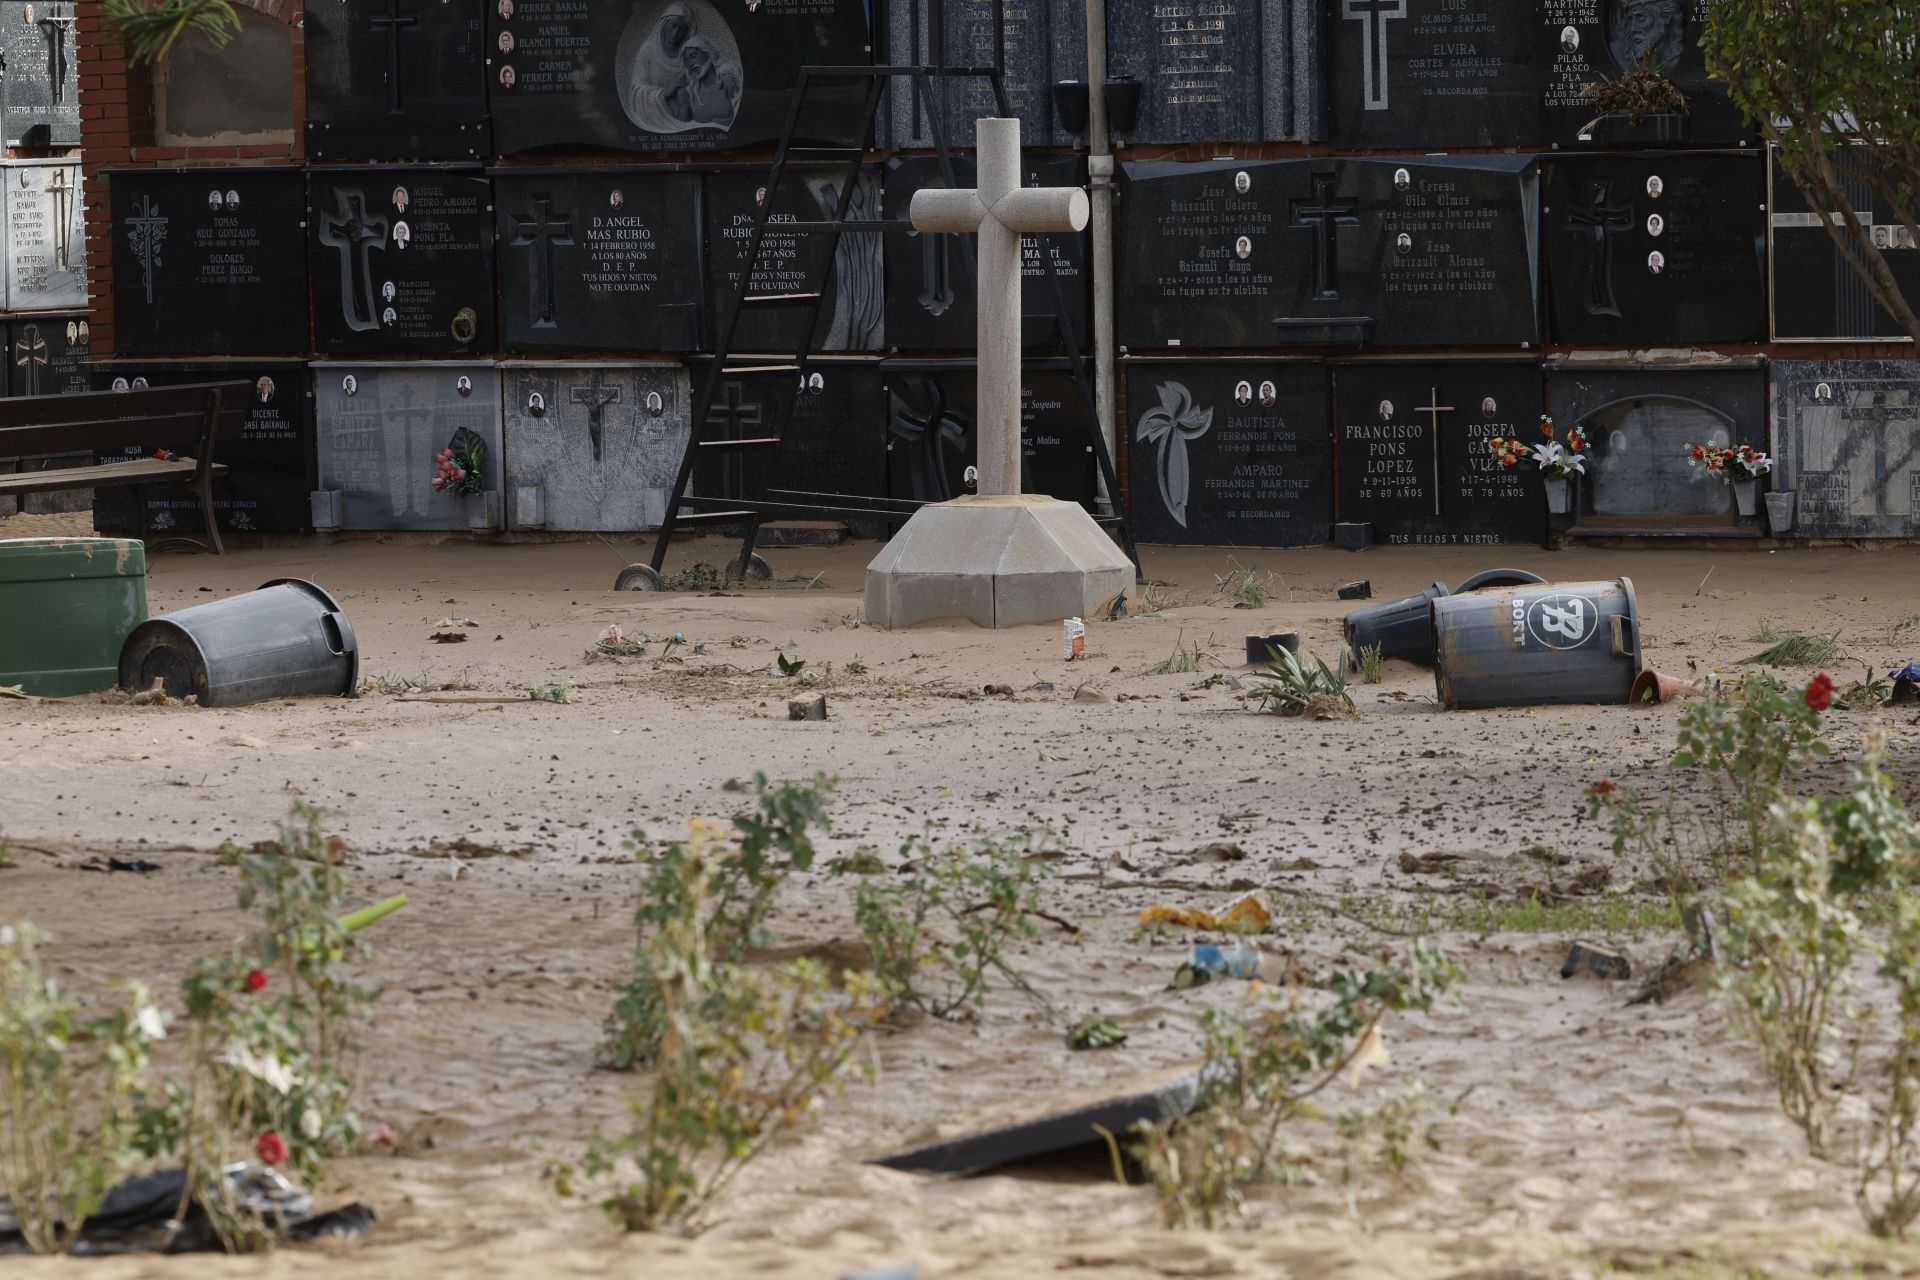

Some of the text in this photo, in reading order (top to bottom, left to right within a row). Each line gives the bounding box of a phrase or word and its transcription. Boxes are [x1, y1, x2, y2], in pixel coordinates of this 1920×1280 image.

[1544, 0, 1597, 9] MARTINEZ
[1421, 13, 1488, 24] OLMOS SALES
[1578, 16, 1599, 24] AÑOS
[1433, 43, 1477, 56] ELVIRA
[1557, 54, 1584, 63] PILAR
[1553, 63, 1590, 72] BLASCO
[1562, 73, 1581, 82] PLA
[1419, 180, 1455, 192] Teresa
[413, 197, 477, 207] PEDRO AMOROS
[214, 218, 238, 227] TOMAS
[606, 216, 644, 227] ANGEL
[414, 223, 450, 232] VICENTA
[414, 234, 455, 242] PONS PLA
[587, 229, 651, 240] MAS RUBIO
[600, 241, 637, 250] FEBRERO
[779, 239, 796, 248] 1958
[591, 252, 597, 260] A
[599, 252, 614, 260] LOS
[625, 250, 647, 260] AÑOS
[773, 248, 796, 258] AÑOS
[210, 254, 245, 264] DOLORES
[202, 265, 225, 275] PEREZ
[582, 274, 597, 282] TUS
[599, 273, 621, 282] HIJOS
[629, 273, 658, 282] NIETOS
[777, 271, 806, 280] NIETOS
[589, 283, 651, 292] NO TE OLVIDAN
[761, 281, 800, 290] OLVIDAN
[1228, 417, 1285, 428] BAUTISTA
[1346, 425, 1423, 439] FRANCISCO
[1468, 424, 1516, 437] JOSEFA
[1274, 432, 1296, 440] PONS
[1370, 443, 1406, 456] PONS
[1233, 465, 1283, 476] AMPARO
[1368, 460, 1413, 473] LOPEZ
[1205, 480, 1310, 489] FERRANDIS MARTINEZ
[1360, 487, 1423, 498] DE 69 AÑOS
[1462, 489, 1473, 497] DE
[1500, 485, 1525, 497] AÑOS
[1240, 510, 1290, 518] RECORDAMOS
[1391, 534, 1500, 544] TUS HIJOS Y NIETOS
[1512, 599, 1525, 646] BORT
